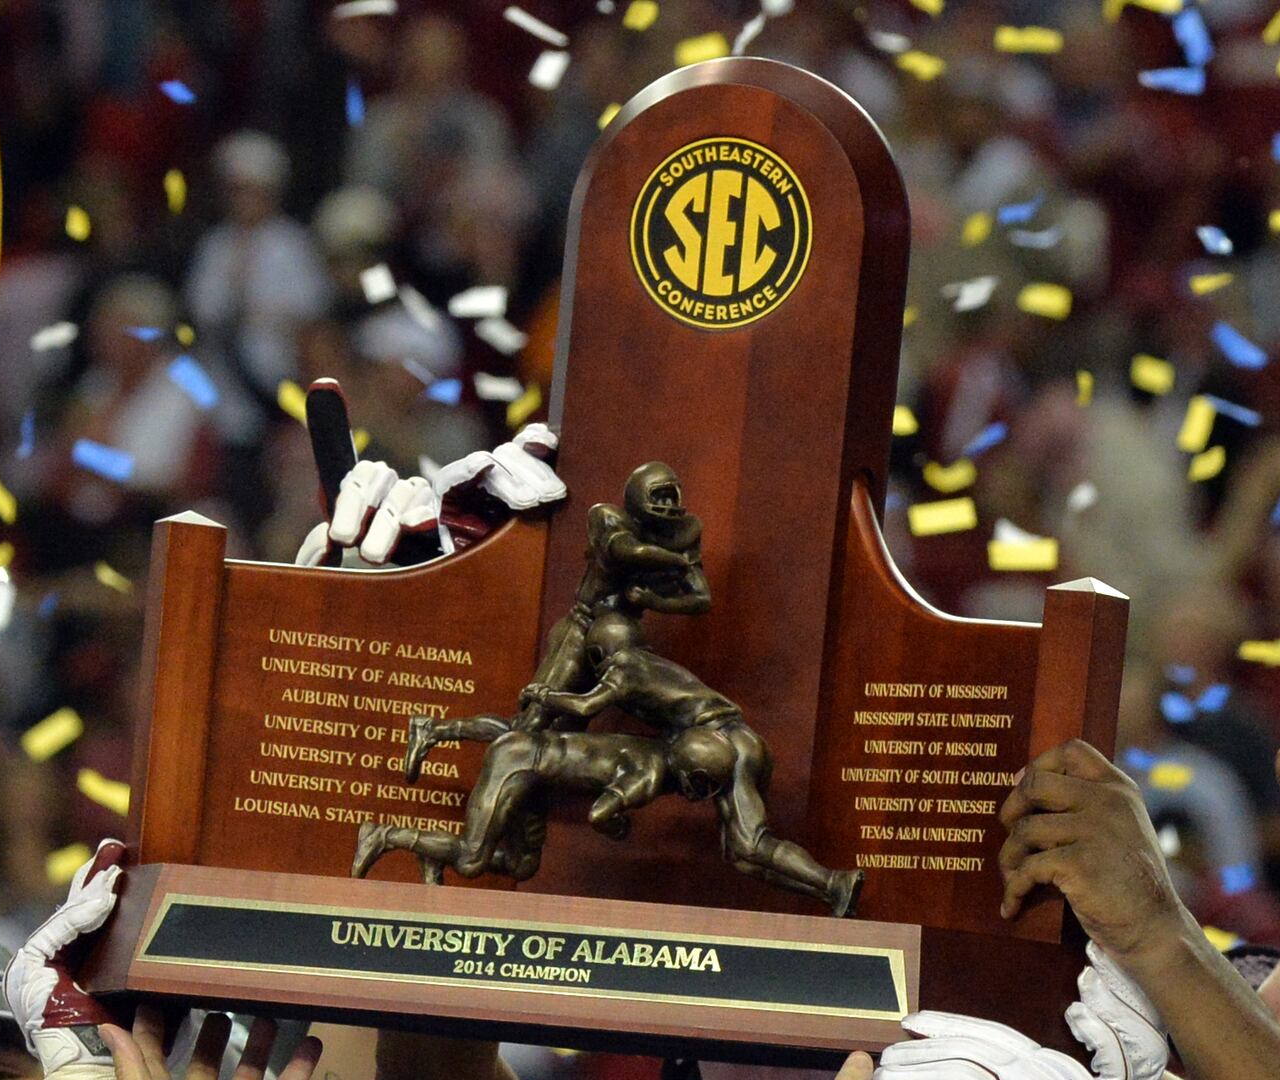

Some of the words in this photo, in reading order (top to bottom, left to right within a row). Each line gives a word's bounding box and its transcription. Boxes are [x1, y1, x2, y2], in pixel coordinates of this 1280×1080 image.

[659, 145, 792, 195] SOUTHEASTERN
[663, 169, 781, 297] SEC
[657, 280, 778, 320] CONFERENCE
[270, 629, 365, 653] UNIVERSITY
[369, 640, 391, 656] OF
[395, 644, 473, 665] ALABAMA
[261, 657, 358, 681] UNIVERSITY
[361, 668, 384, 684] OF
[387, 672, 475, 694] ARKANSAS
[864, 683, 927, 698] UNIVERSITY
[928, 684, 944, 698] OF
[945, 685, 1008, 700] MISSISSIPPI
[281, 688, 349, 708] AUBURN
[353, 695, 449, 719] UNIVERSITY
[853, 711, 915, 726] MISSISSIPPI
[916, 712, 950, 727] STATE
[951, 713, 1014, 729] UNIVERSITY
[264, 714, 360, 738] UNIVERSITY
[364, 725, 387, 741] OF
[391, 729, 461, 750] FLDA
[864, 740, 927, 756] UNIVERSITY
[928, 741, 944, 756] OF
[945, 742, 998, 757] MISSOURI
[260, 742, 356, 766] UNIVERSITY
[360, 753, 383, 769] OF
[387, 757, 459, 778] GERGIA
[841, 768, 904, 784] UNIVERSITY
[905, 769, 921, 784] OF
[922, 770, 959, 785] SOUTH
[961, 771, 1017, 786] CAROLINA
[250, 770, 346, 794] UNIVERSITY
[350, 781, 372, 797] OF
[376, 784, 465, 807] KENTUCKY
[855, 797, 917, 812] UNIVERSITY
[918, 798, 934, 813] OF
[936, 799, 996, 814] TENNESSEE
[234, 797, 321, 819] LOUISIANA
[325, 807, 373, 825] STATE
[379, 813, 465, 835] UNIVERSIT
[860, 826, 894, 840] TEXAS
[896, 827, 920, 841] A&M
[922, 827, 986, 843] UNIVERSITY
[855, 854, 920, 869] VANDERBILT
[921, 856, 985, 871] UNIVERSITY
[331, 921, 515, 957] UNIVERSITY
[522, 935, 565, 961] OF
[572, 939, 721, 972] ALABAMA
[453, 959, 495, 977] 2014
[500, 963, 591, 983] CHAMPION
